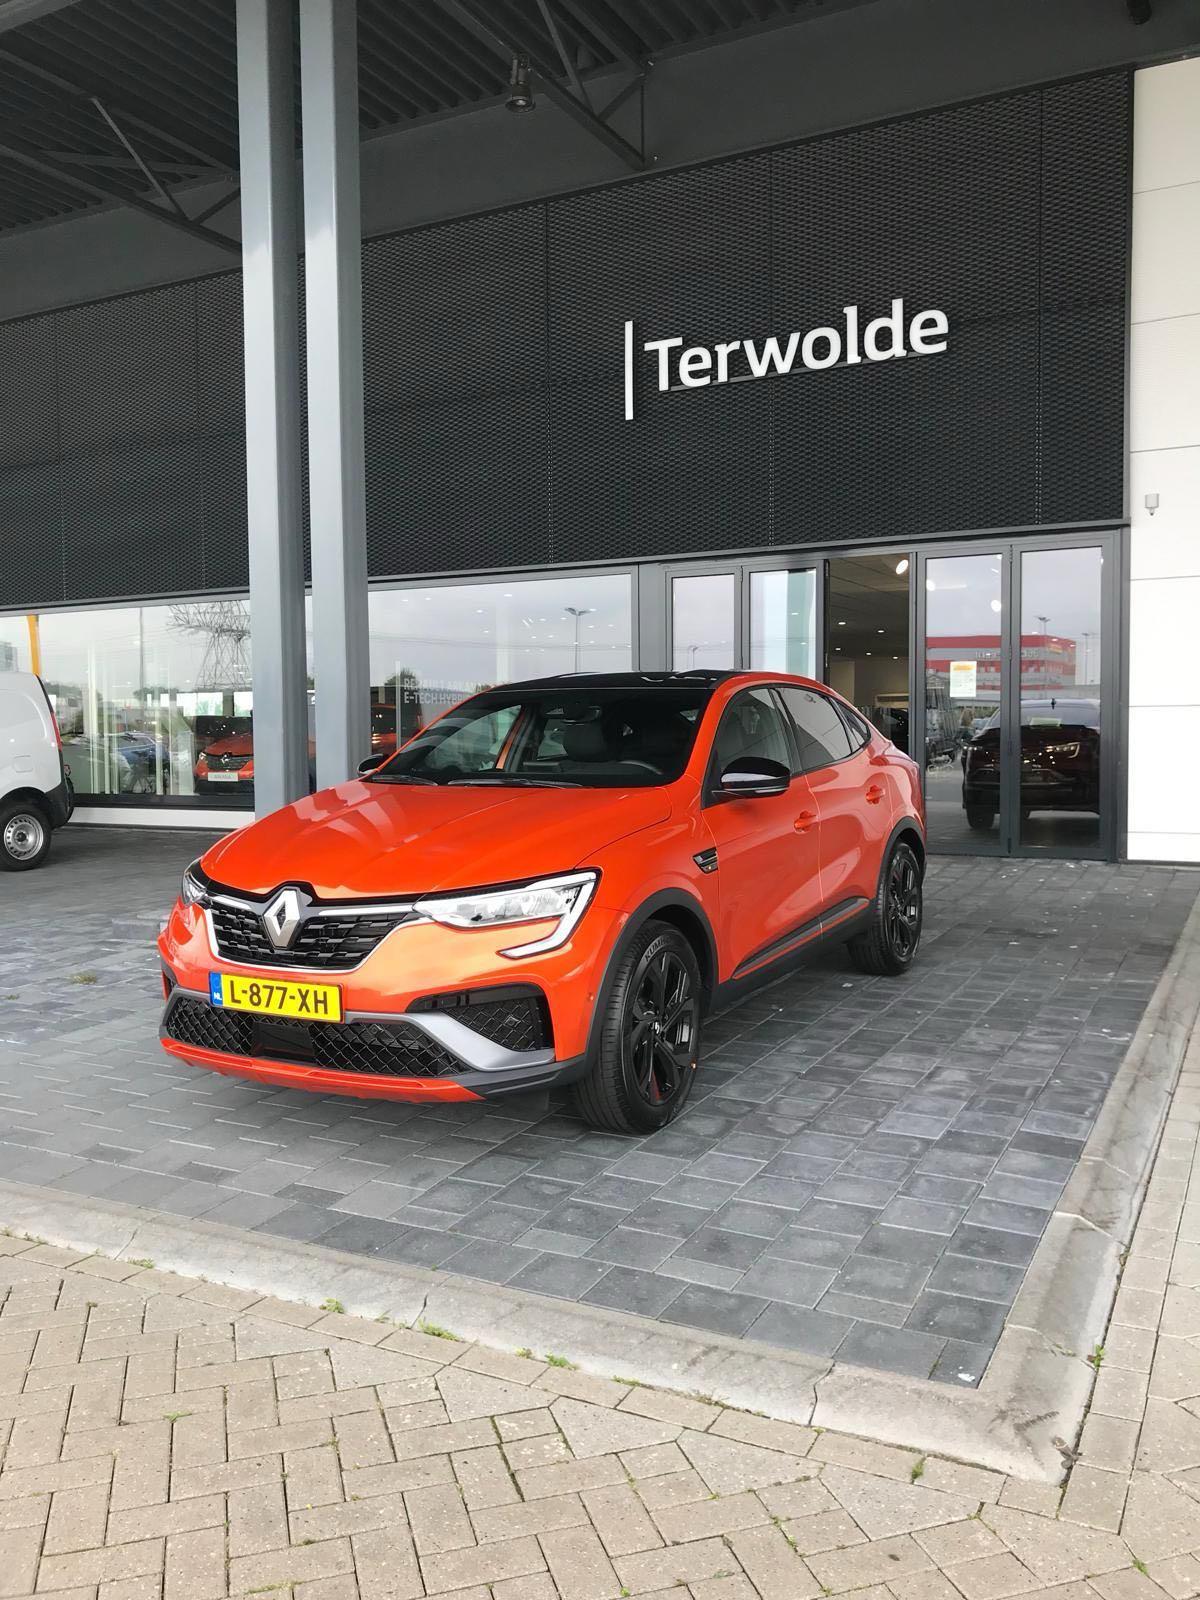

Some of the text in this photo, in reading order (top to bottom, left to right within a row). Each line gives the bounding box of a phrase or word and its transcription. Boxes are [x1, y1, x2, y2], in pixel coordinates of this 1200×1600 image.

[644, 298, 949, 392] Terwolde
[404, 691, 438, 704] E-TECH
[230, 980, 328, 1015] L-877-XH
